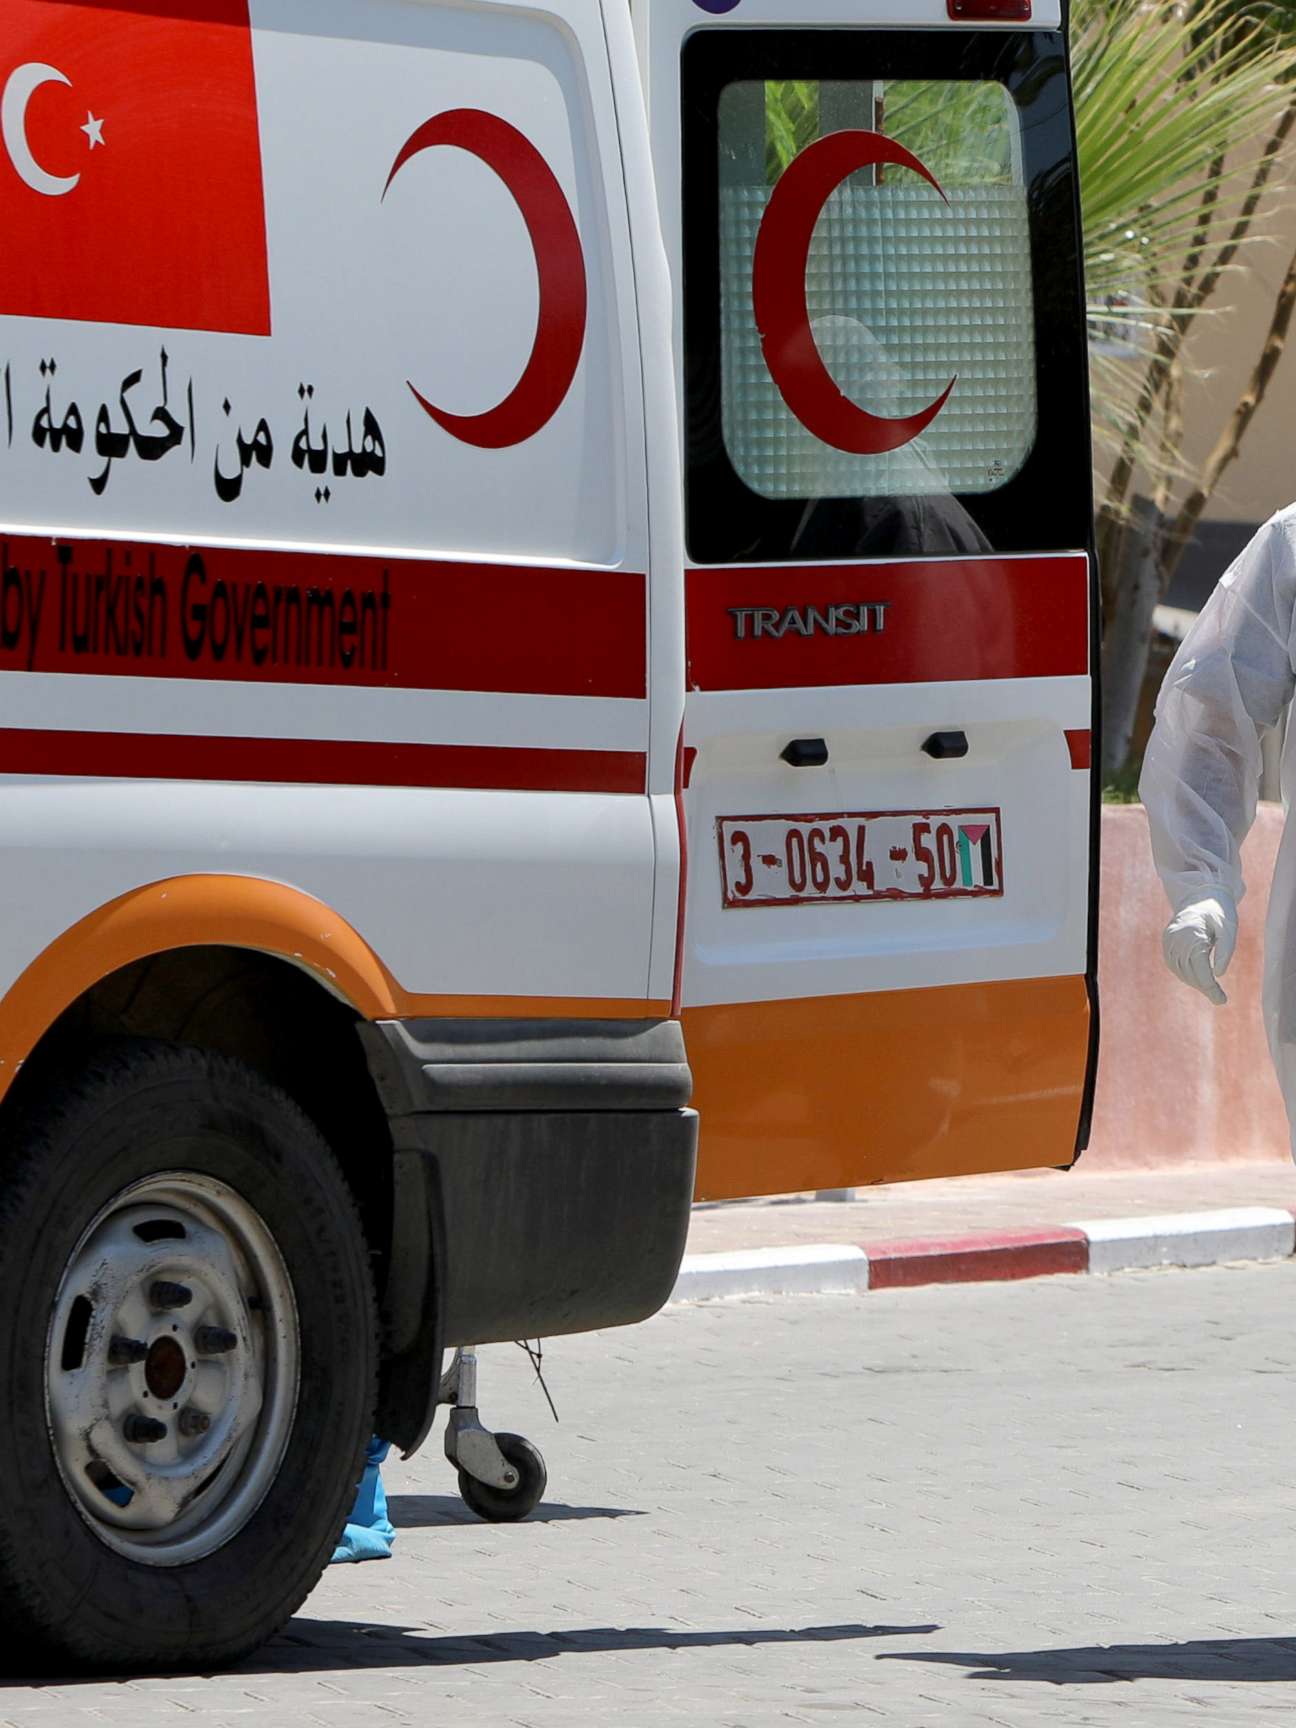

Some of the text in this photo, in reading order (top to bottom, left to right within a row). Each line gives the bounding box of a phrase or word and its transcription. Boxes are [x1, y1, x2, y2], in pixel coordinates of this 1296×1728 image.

[31, 344, 196, 497] الحكومة
[214, 395, 274, 503] من
[290, 382, 387, 504] هدية
[1, 541, 392, 672] by Turkish Government
[728, 602, 890, 640] TRANSIT
